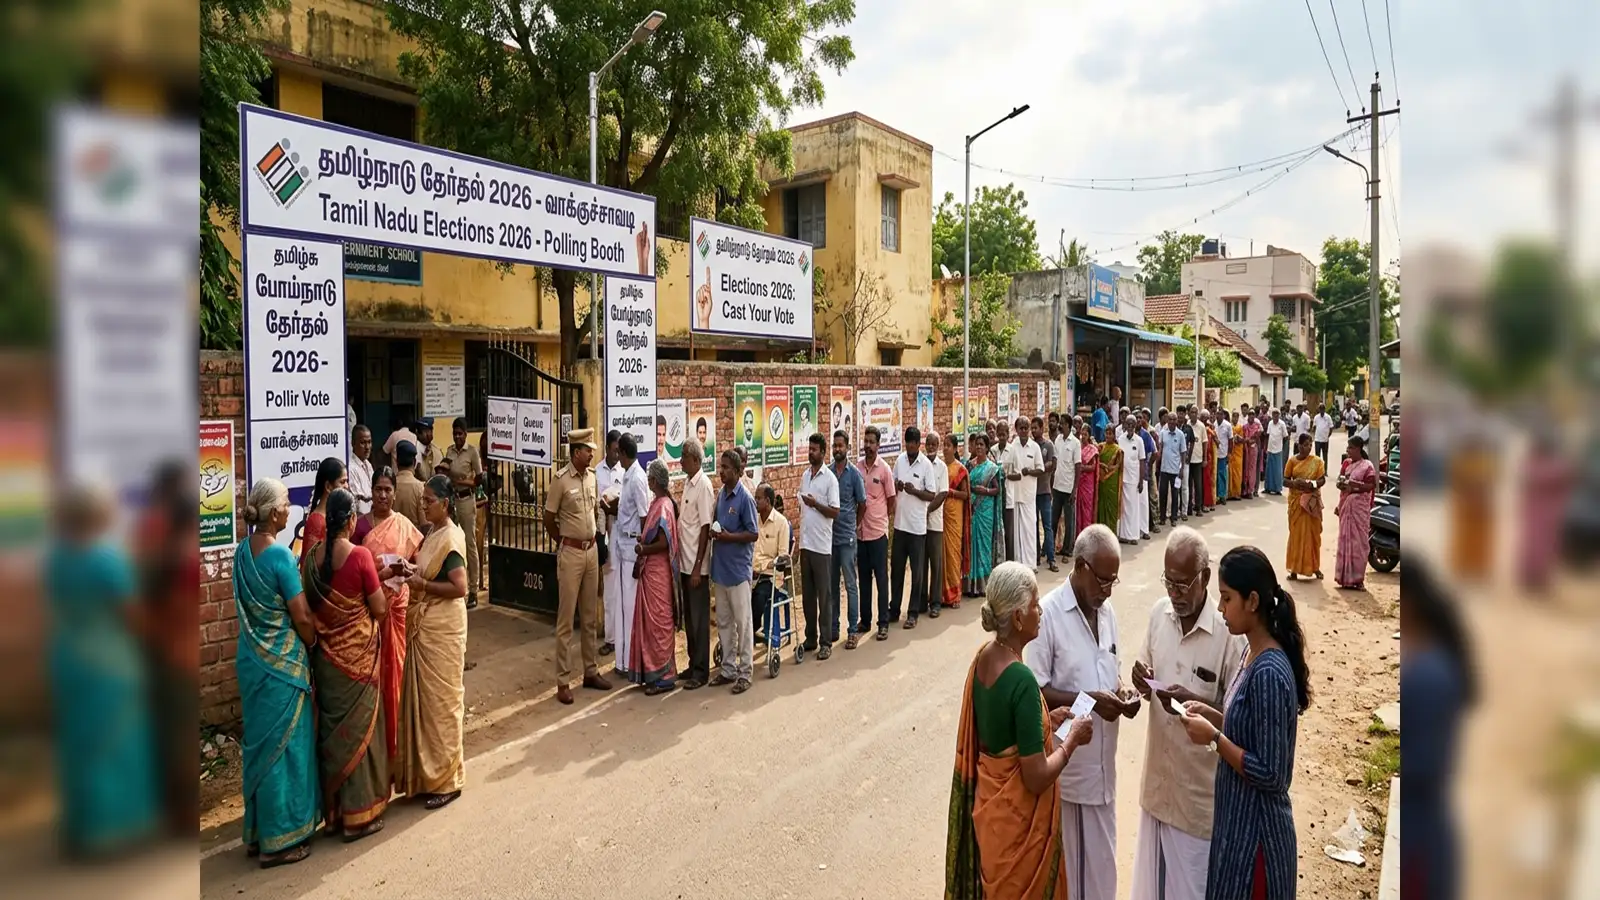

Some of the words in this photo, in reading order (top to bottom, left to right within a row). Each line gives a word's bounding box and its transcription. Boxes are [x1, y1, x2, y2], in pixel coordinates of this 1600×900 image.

[318, 145, 416, 195] தமிழ்நாடு
[420, 162, 485, 205] தேர்தல்
[489, 179, 532, 211] 2026
[545, 191, 636, 235] வாக்குச்சாவடி
[318, 192, 368, 227] Tamil
[374, 201, 418, 234] Nadu
[424, 210, 494, 245] Elections
[499, 222, 532, 250] 2026
[544, 229, 587, 263] Polling
[590, 237, 625, 263] Booth
[777, 249, 795, 265] 2026
[721, 273, 768, 297] Elections
[770, 281, 796, 301] 2026:
[722, 300, 746, 321] Cast
[748, 303, 772, 323] Your
[773, 306, 795, 325] Vote
[266, 309, 329, 341] தேர்தல்
[265, 390, 299, 407] Pollir
[302, 389, 330, 406] Vote
[634, 384, 649, 397] Vote
[521, 431, 531, 442] for
[531, 432, 545, 443] Men
[523, 571, 544, 591] 2026
